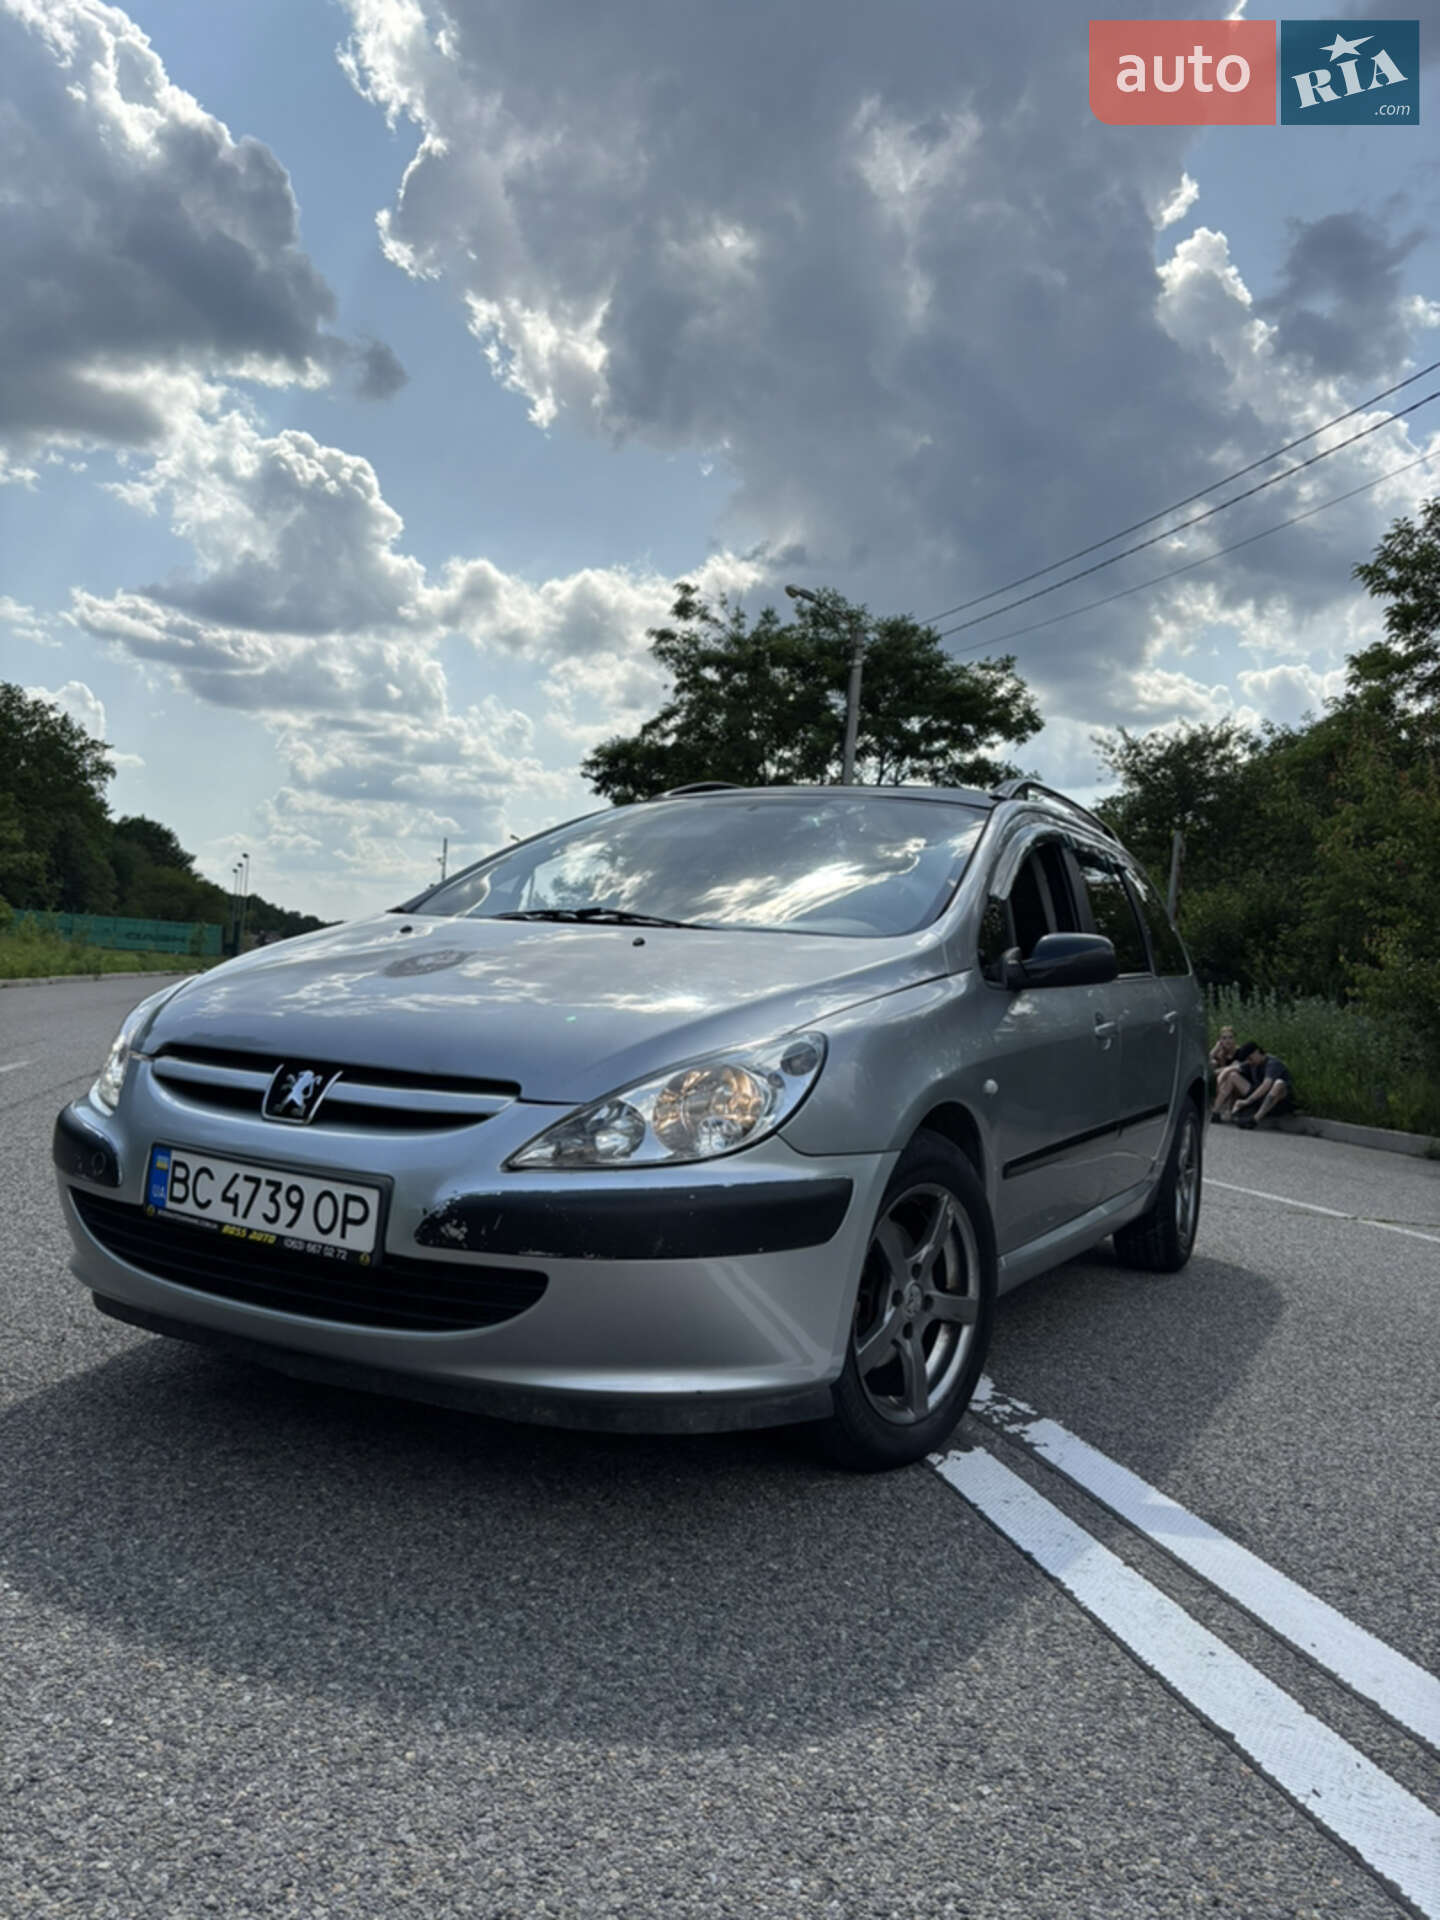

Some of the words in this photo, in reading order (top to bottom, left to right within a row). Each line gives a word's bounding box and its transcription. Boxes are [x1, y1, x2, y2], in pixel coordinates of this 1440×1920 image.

[152, 1184, 167, 1198] UA
[169, 1160, 214, 1210] BC
[221, 1173, 305, 1228] 4739
[313, 1190, 370, 1239] OP
[248, 1232, 276, 1244] AUTO
[337, 1249, 348, 1261] 72
